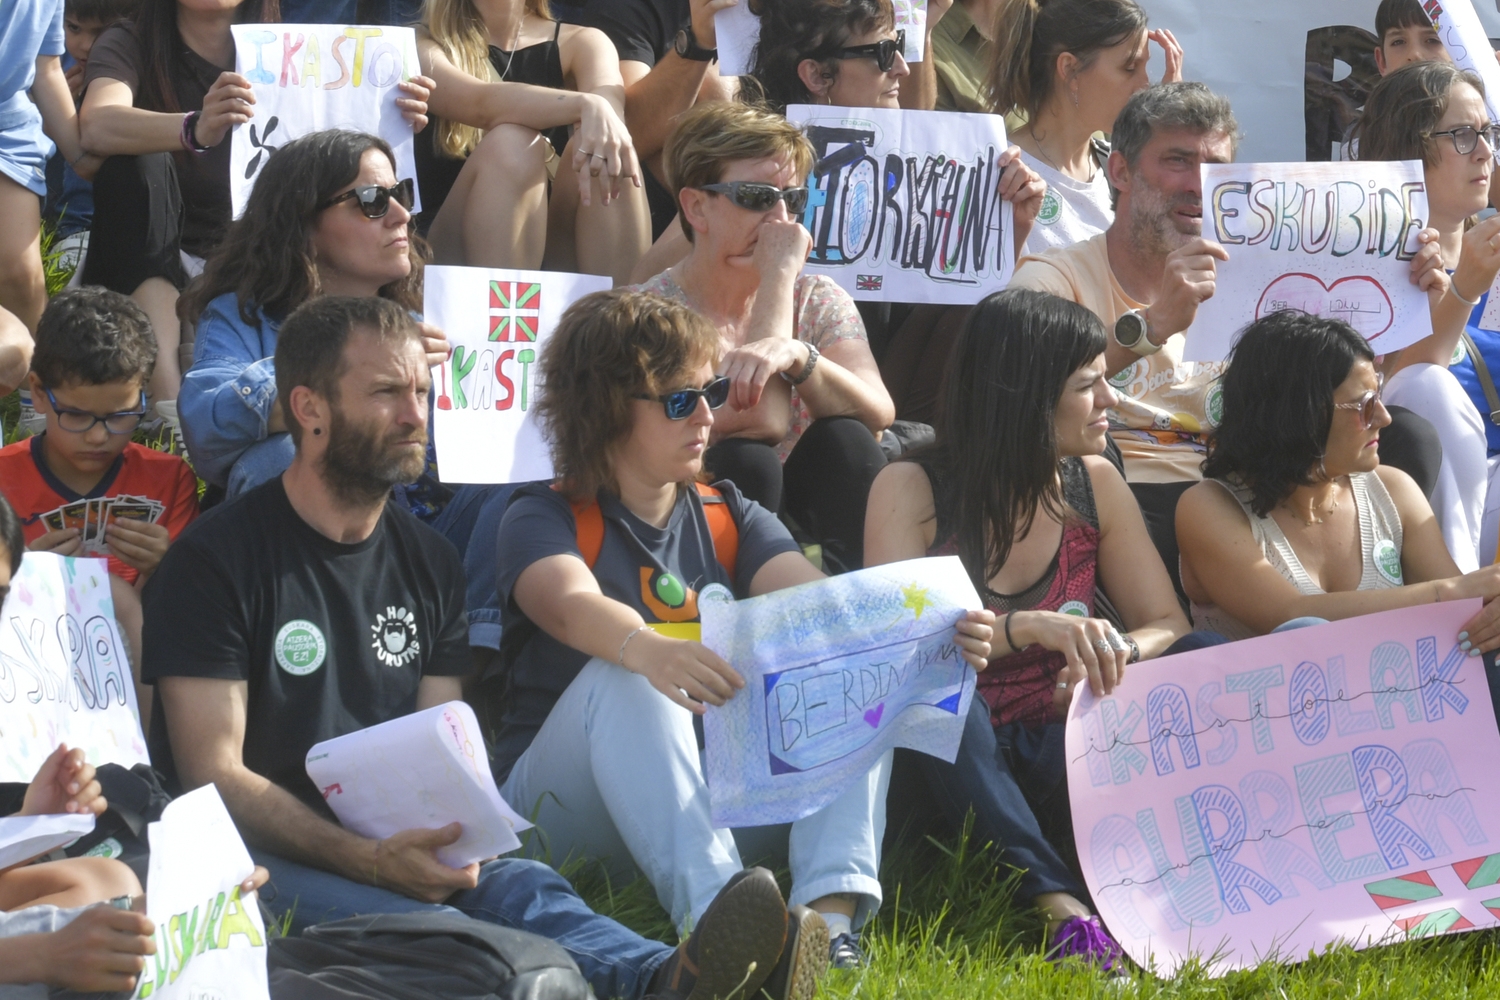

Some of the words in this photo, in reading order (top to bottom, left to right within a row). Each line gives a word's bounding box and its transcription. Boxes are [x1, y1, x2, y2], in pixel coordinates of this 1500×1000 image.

[437, 345, 537, 412] IKAST
[371, 613, 387, 633] LA
[386, 606, 417, 636] HORA
[286, 635, 313, 644] ATZERA
[371, 638, 420, 668] TURUTAS
[293, 651, 309, 662] EZ!
[1085, 636, 1468, 787] IKASTOLAK
[1089, 738, 1488, 938] AURRERA
